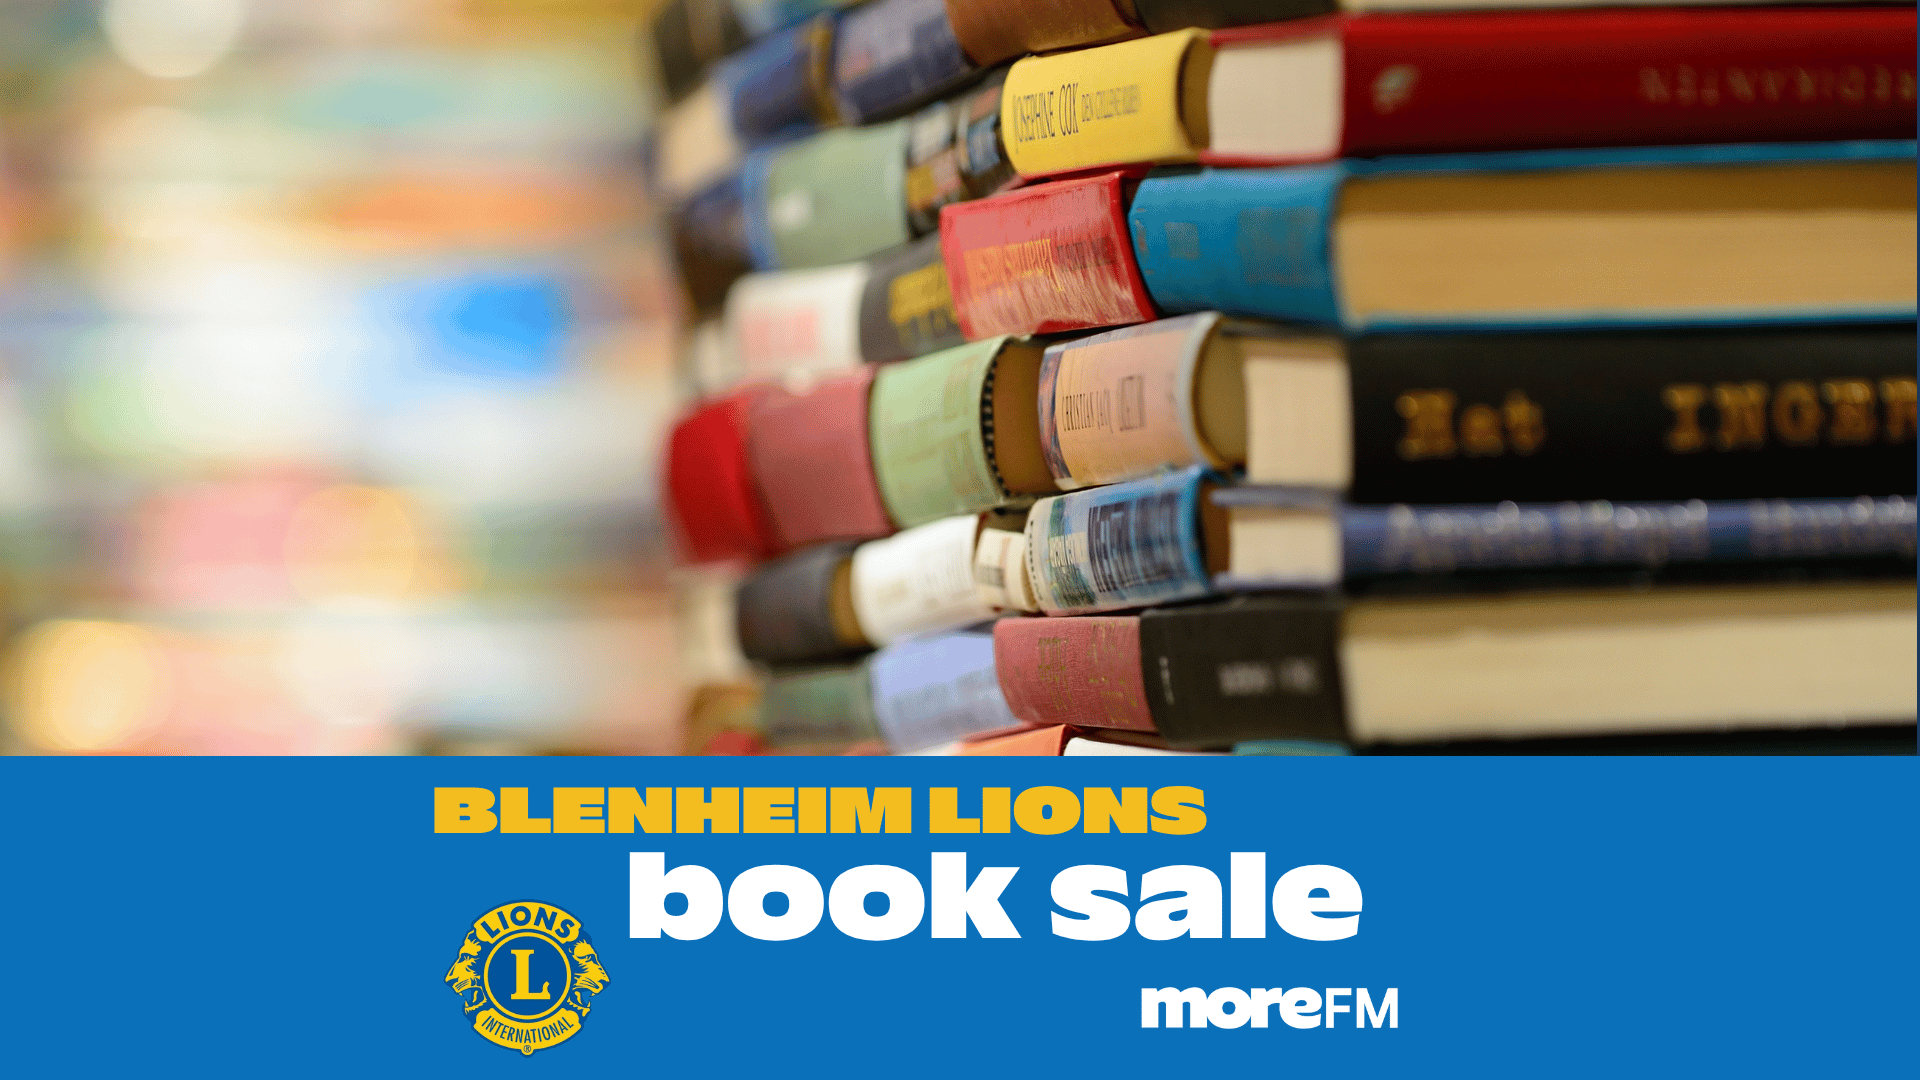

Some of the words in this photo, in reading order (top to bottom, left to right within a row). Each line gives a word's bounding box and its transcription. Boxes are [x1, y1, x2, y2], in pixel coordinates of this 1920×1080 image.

[1012, 90, 1056, 154] JOSEPHINE
[1059, 83, 1079, 136] COX
[1061, 392, 1094, 432] CHRISTIAN
